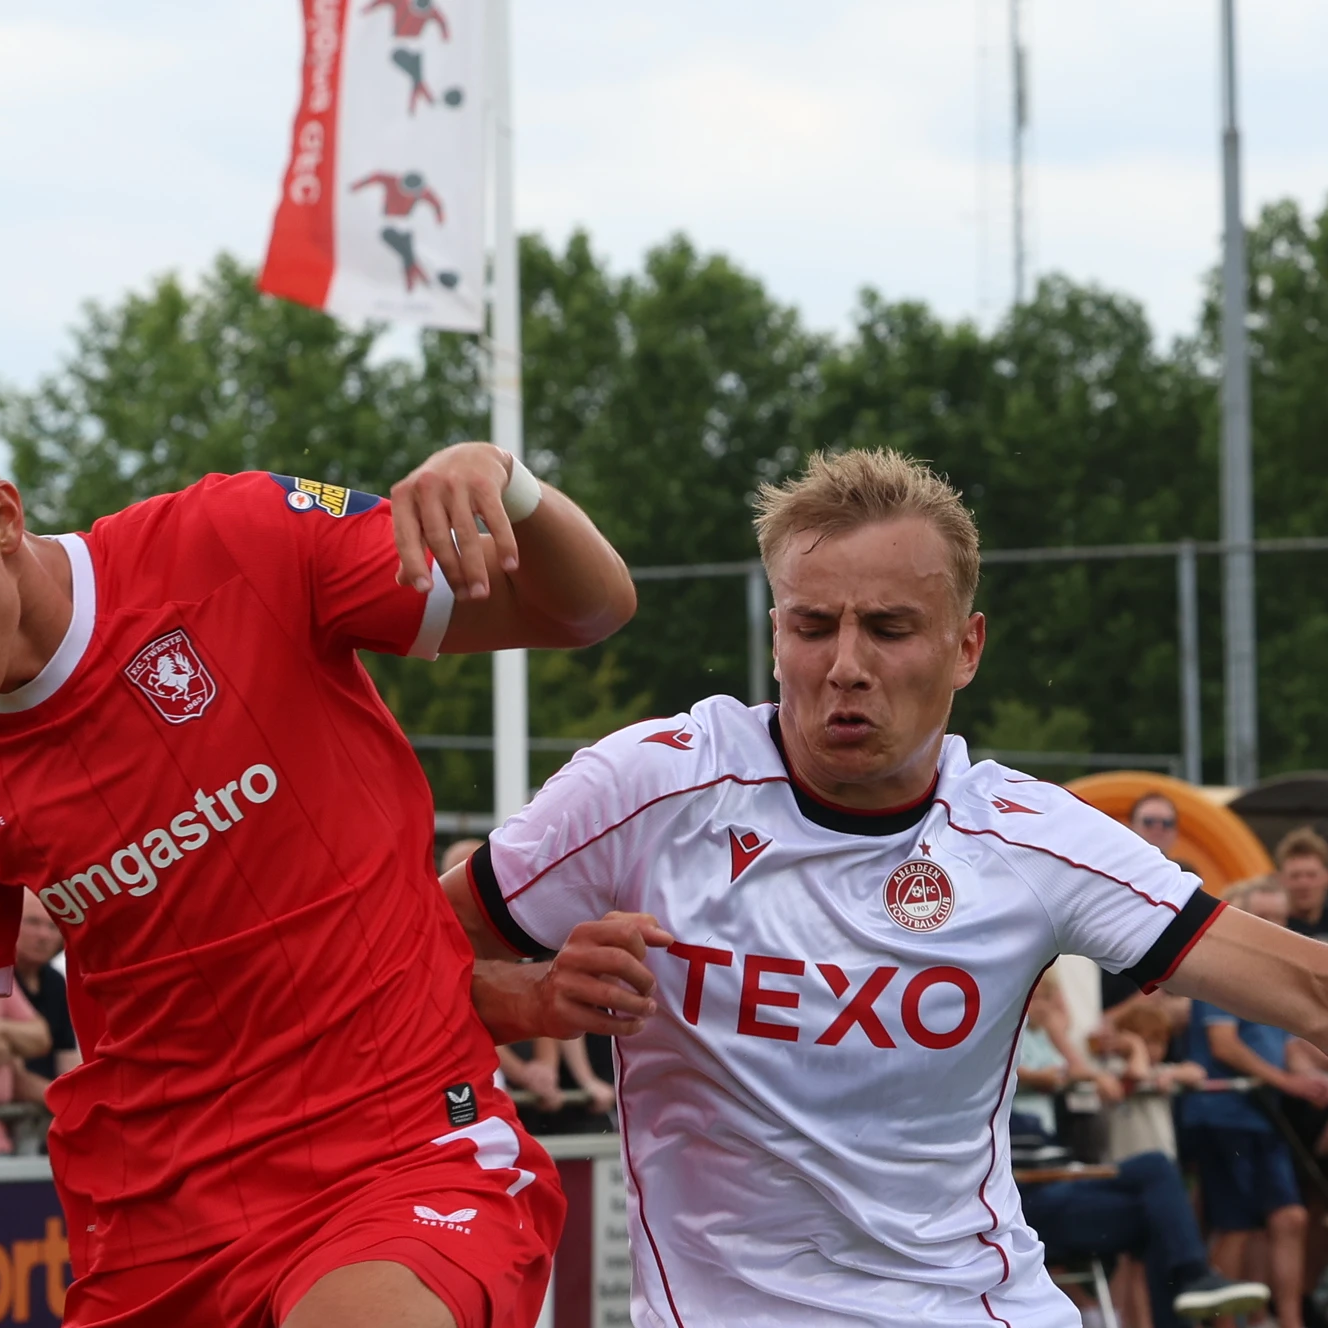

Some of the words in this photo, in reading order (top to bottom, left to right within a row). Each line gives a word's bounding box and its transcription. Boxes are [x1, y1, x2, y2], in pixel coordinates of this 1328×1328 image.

[144, 634, 183, 662] TWENTE
[183, 695, 204, 714] 1965
[893, 863, 941, 885] ABERDEEN
[889, 903, 938, 929] FOOTBALL
[935, 896, 951, 921] CLUB
[666, 941, 981, 1050] TEXO
